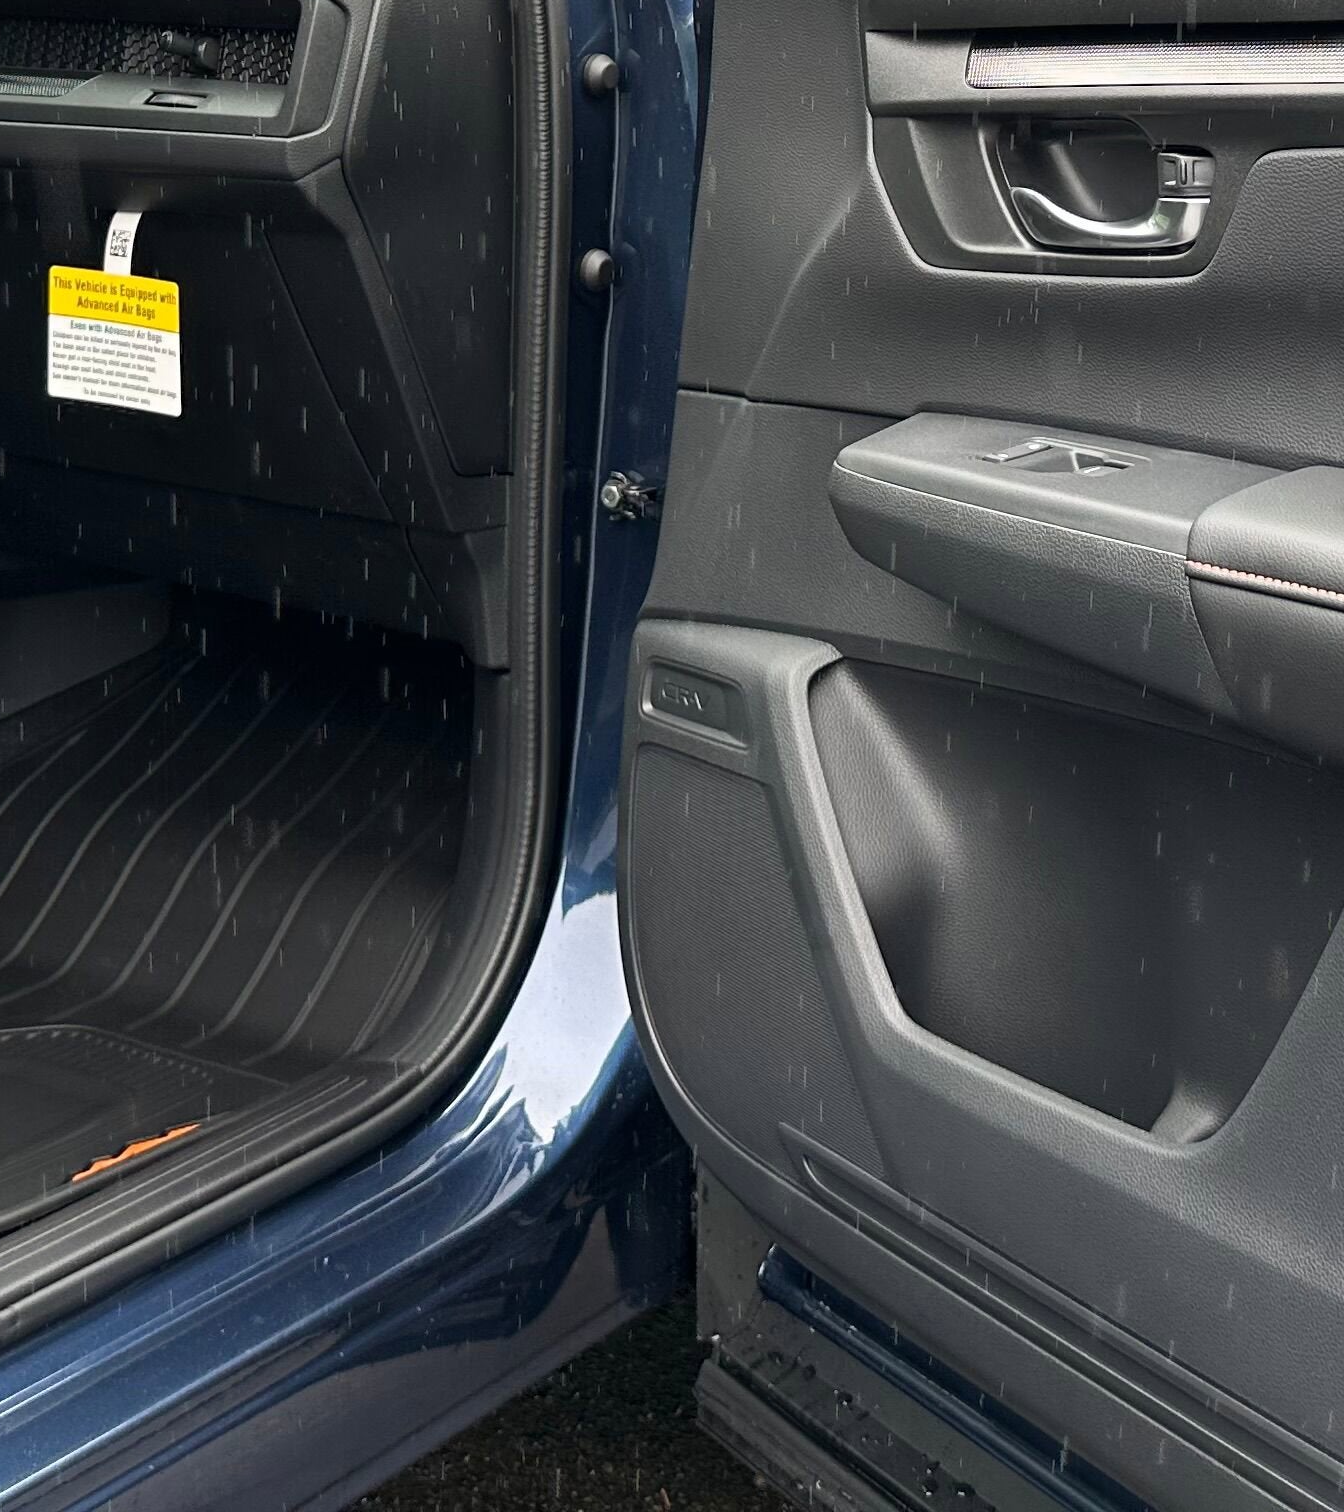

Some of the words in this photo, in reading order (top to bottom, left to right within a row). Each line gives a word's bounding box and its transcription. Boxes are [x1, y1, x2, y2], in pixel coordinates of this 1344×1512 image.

[53, 275, 73, 289] This
[75, 278, 108, 295] Vehicle
[110, 284, 118, 295] is
[120, 284, 158, 302] Equipped
[159, 292, 177, 305] with
[77, 296, 120, 313] Advanced
[122, 301, 134, 314] Air
[136, 304, 156, 321] Bags
